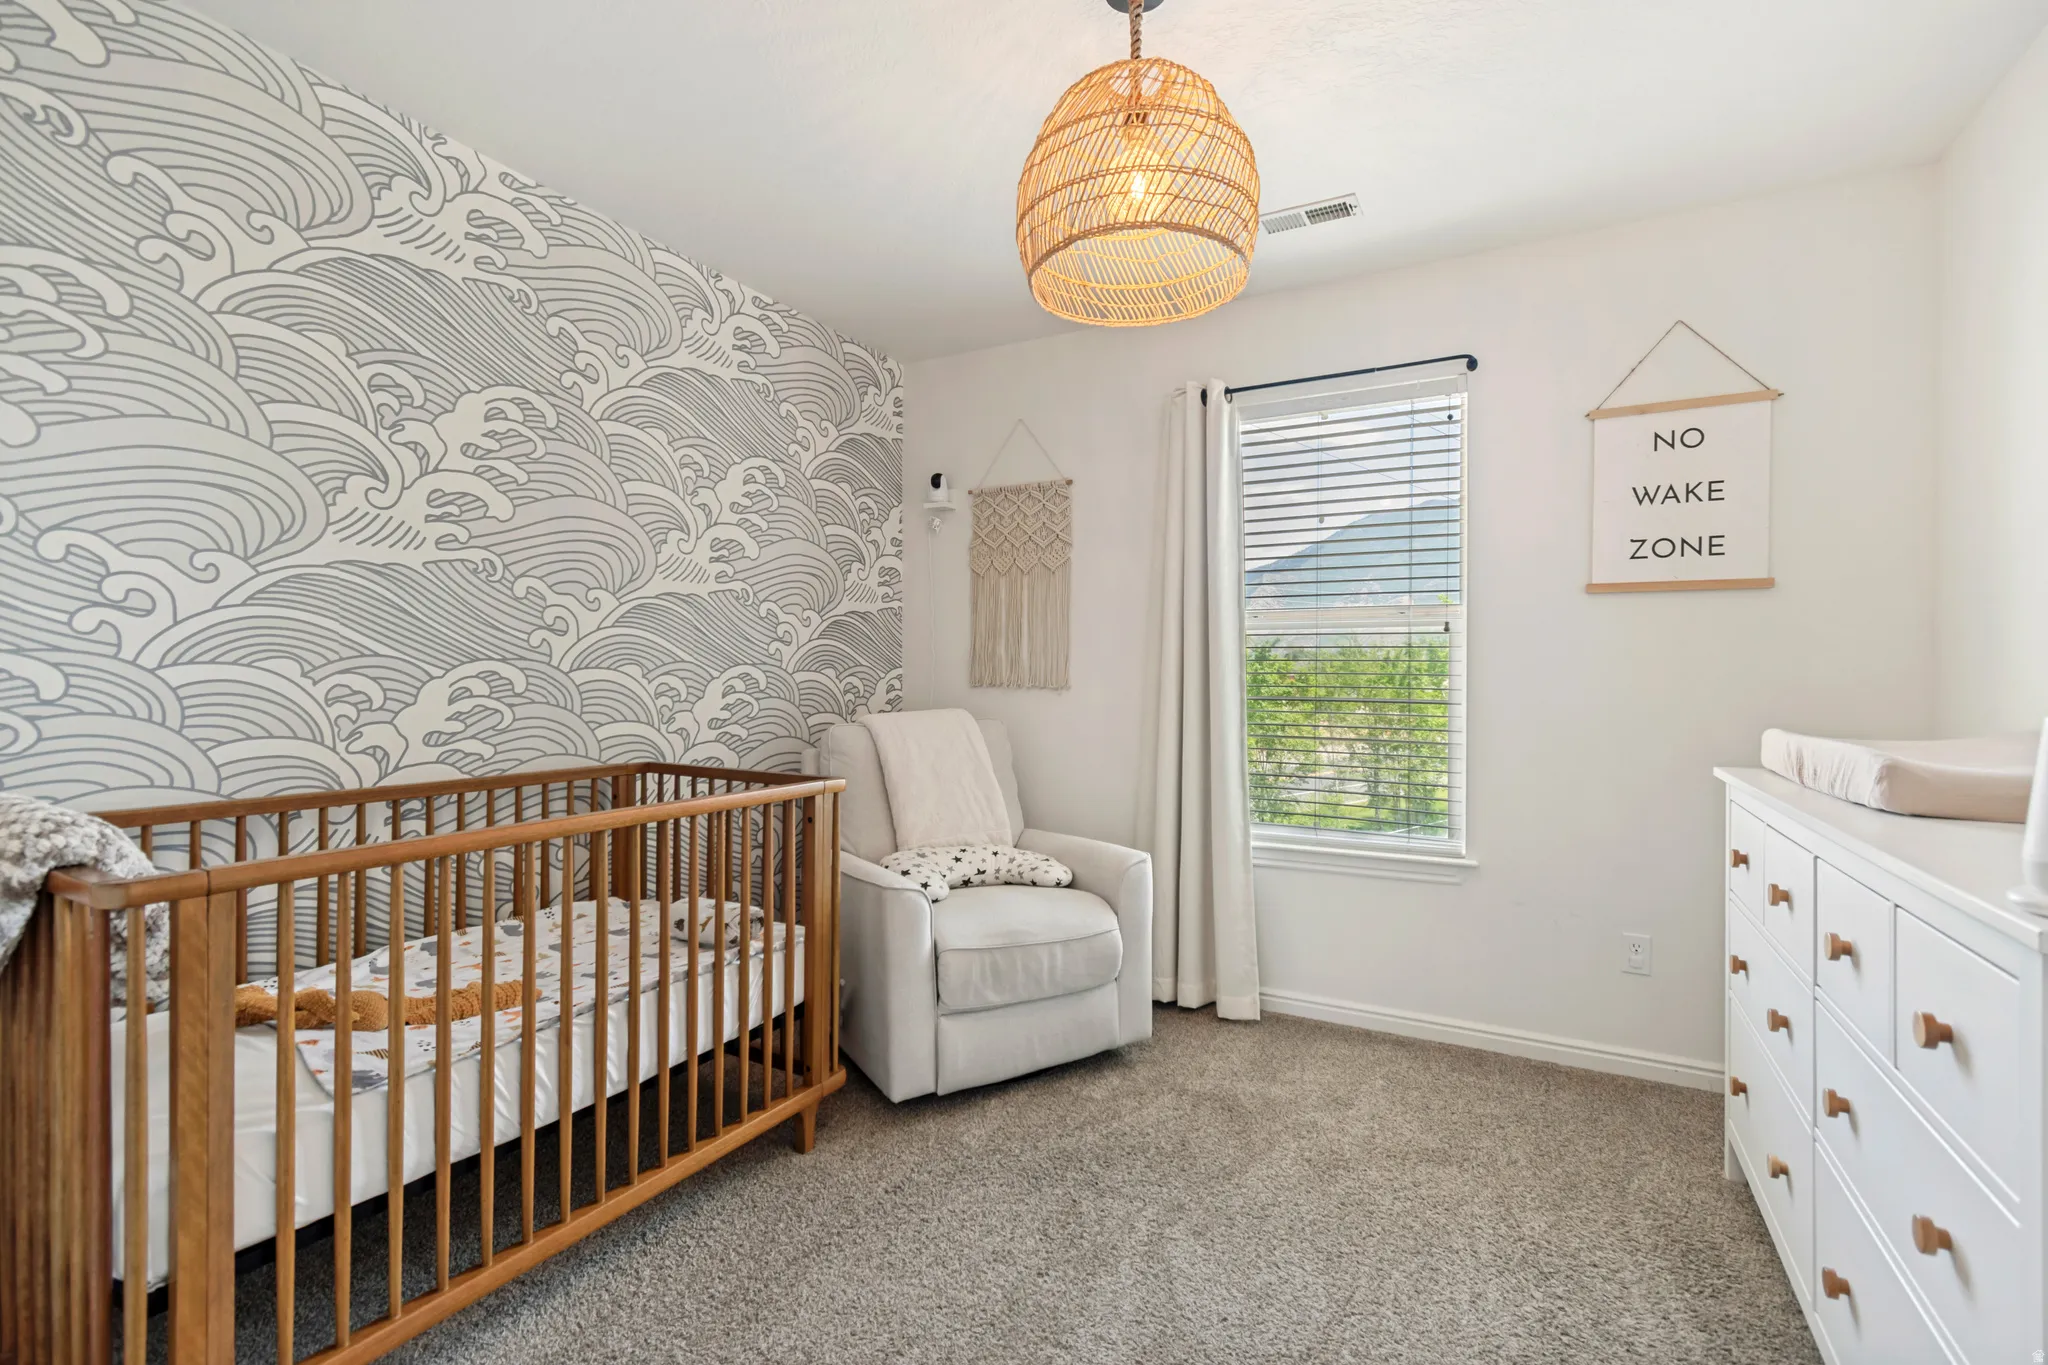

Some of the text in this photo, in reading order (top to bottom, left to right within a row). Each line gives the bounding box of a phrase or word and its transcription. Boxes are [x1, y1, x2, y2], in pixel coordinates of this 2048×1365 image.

[1653, 427, 1705, 452] NO
[1631, 480, 1725, 506] WAKE
[1629, 535, 1726, 560] ZONE
